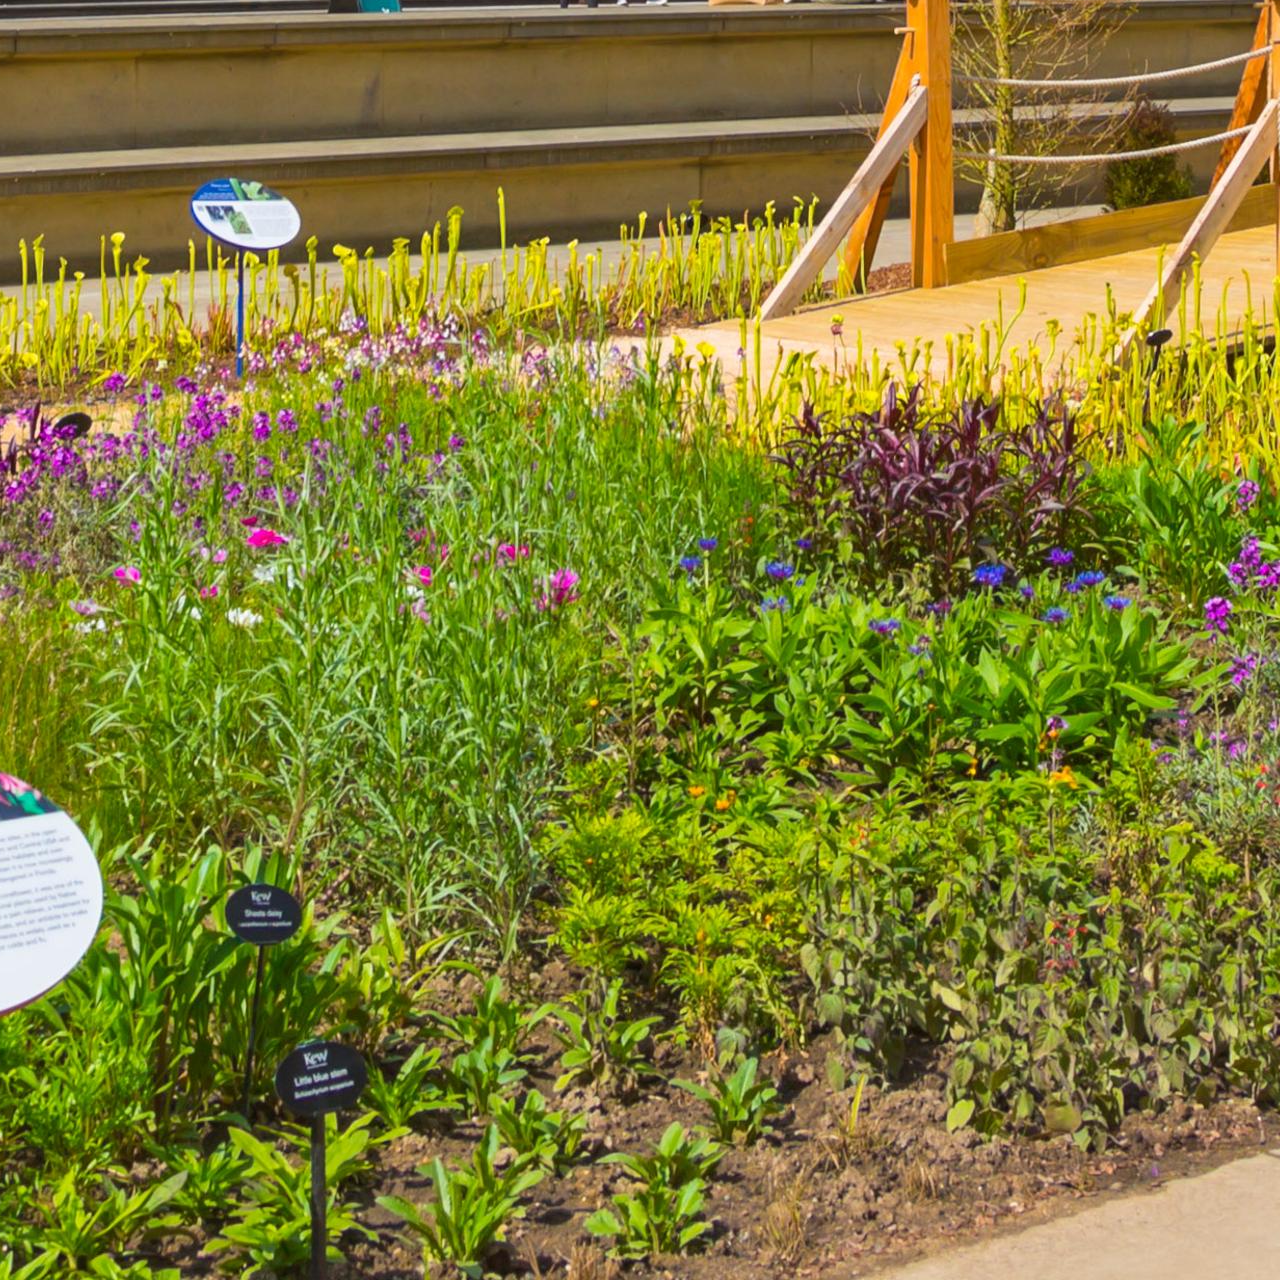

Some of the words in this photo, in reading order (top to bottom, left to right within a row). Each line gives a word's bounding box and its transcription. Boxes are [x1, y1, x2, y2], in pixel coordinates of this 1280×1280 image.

[251, 891, 271, 902] Kew
[304, 1049, 328, 1065] Kew
[294, 1076, 312, 1087] Little
[313, 1072, 329, 1083] blue
[330, 1068, 348, 1078] stem
